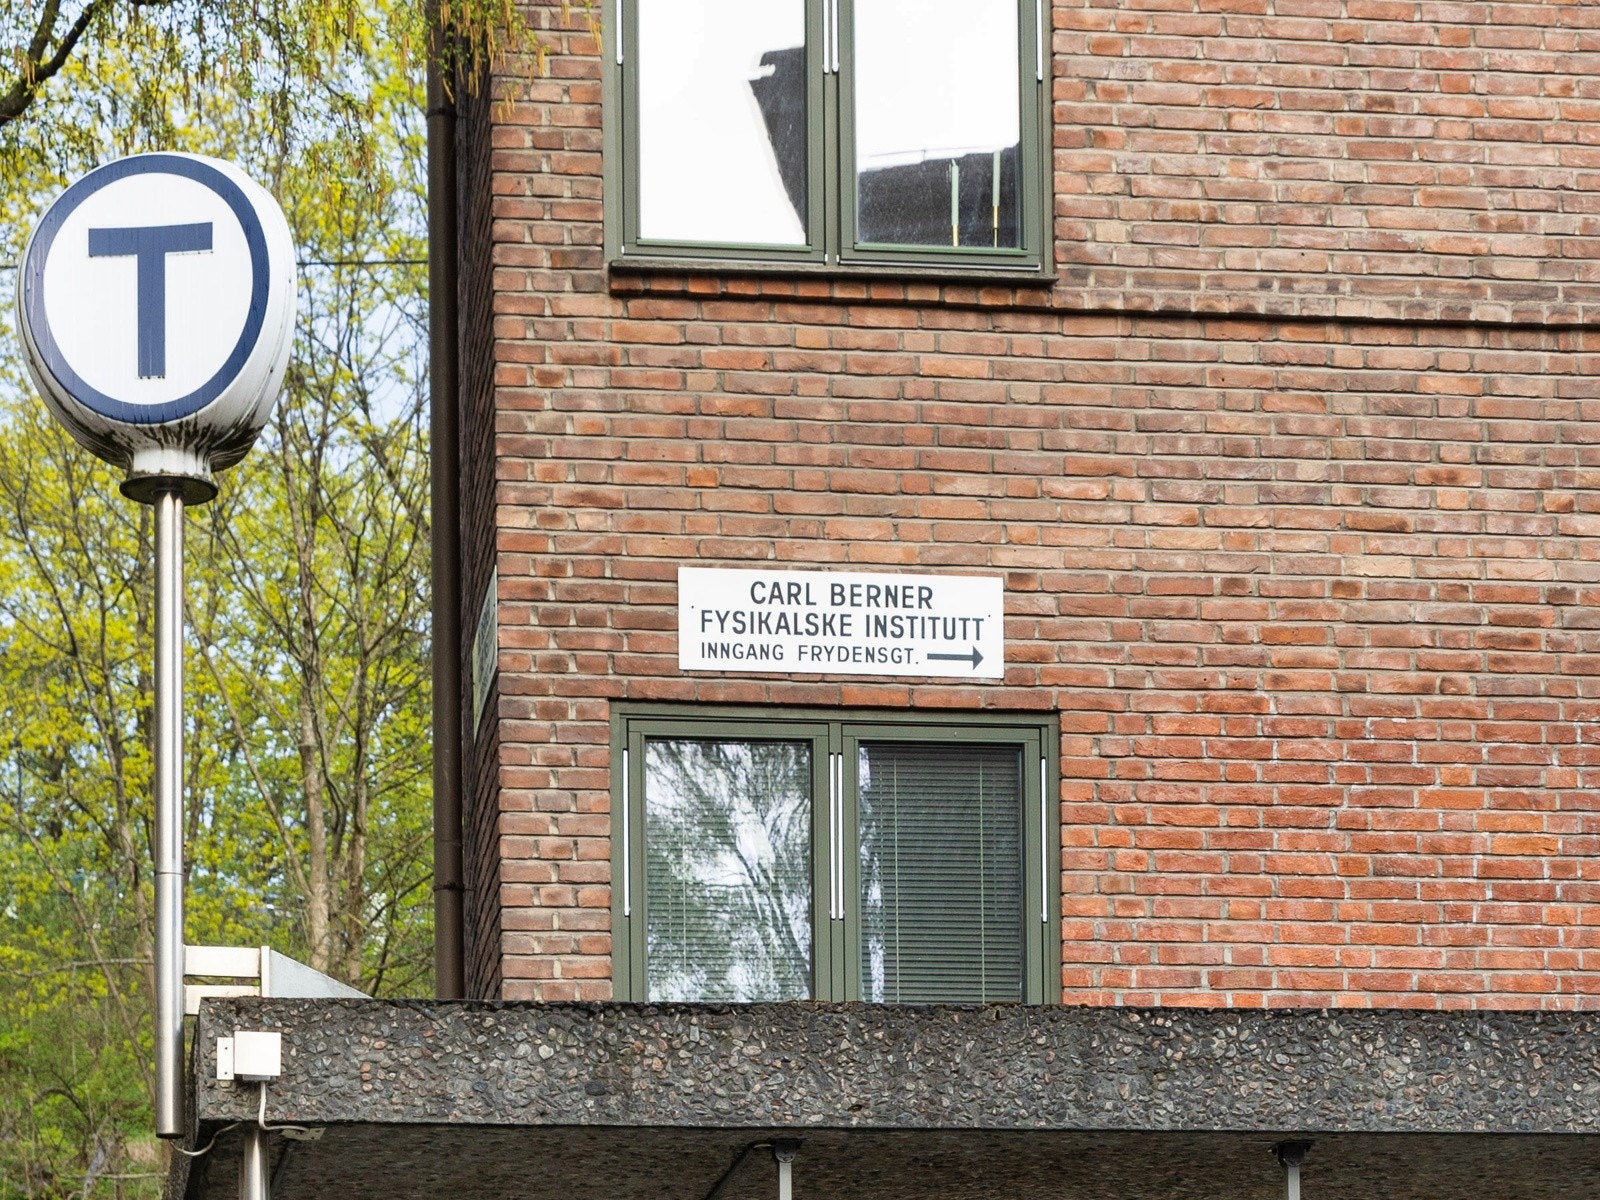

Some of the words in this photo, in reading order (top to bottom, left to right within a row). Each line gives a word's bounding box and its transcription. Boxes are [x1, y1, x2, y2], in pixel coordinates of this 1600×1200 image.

[88, 222, 213, 380] T
[750, 581, 817, 606] CARL
[830, 583, 933, 610] BERNER
[701, 609, 852, 637] FYSIKALSKE
[865, 614, 985, 641] INSTITUTT
[701, 642, 784, 661] INNGANG
[798, 645, 919, 665] FRYDENSGT.
